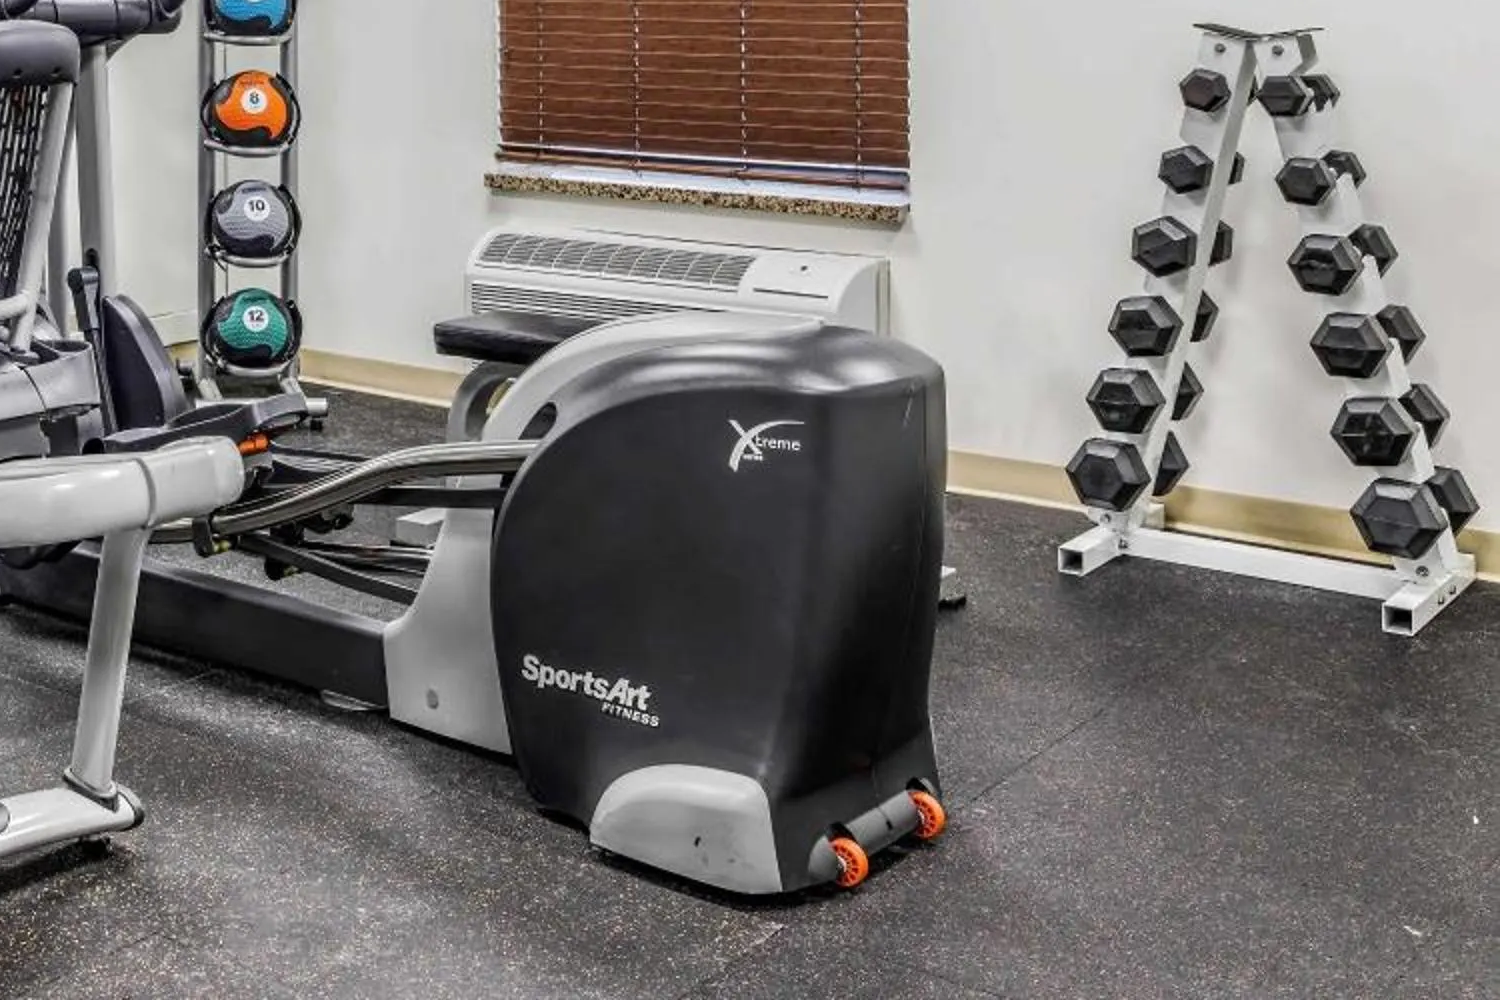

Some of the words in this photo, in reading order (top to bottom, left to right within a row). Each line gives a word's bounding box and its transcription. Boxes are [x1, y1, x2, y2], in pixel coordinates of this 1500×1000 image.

[249, 92, 260, 105] 8
[248, 199, 265, 212] 10
[248, 309, 265, 322] 12
[521, 653, 652, 711] SportsArt
[601, 701, 660, 727] FITNESS
